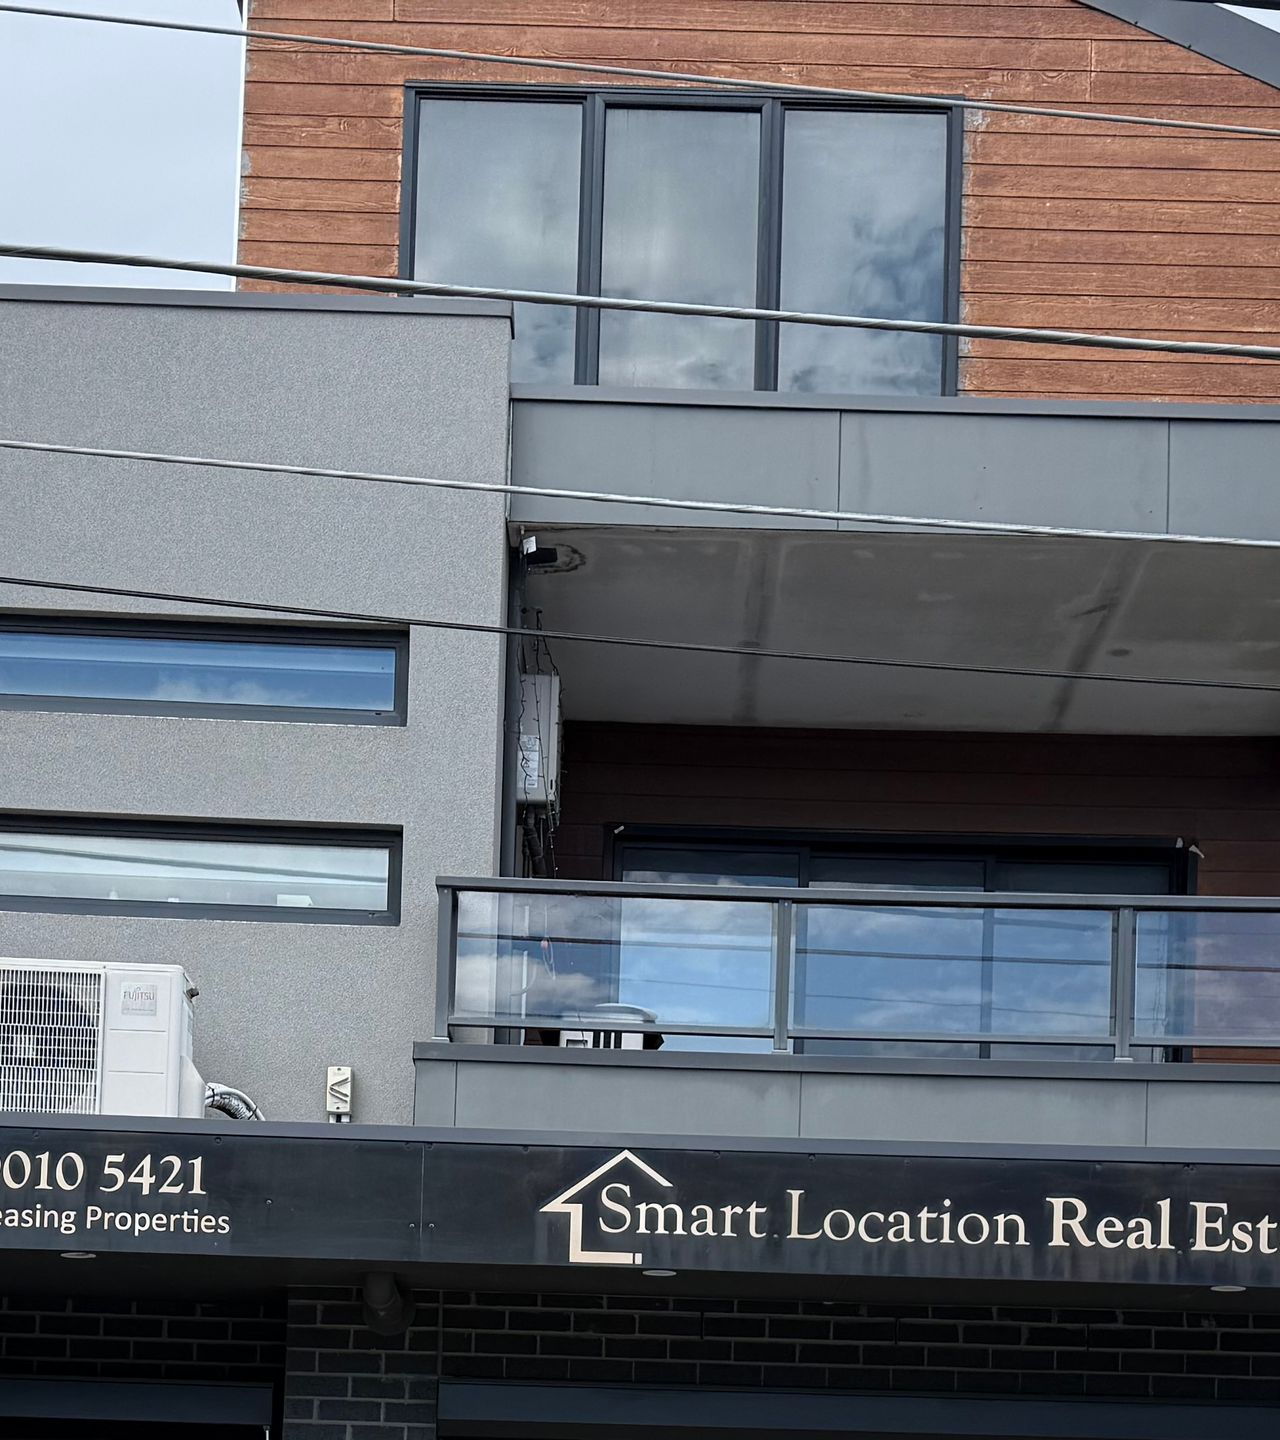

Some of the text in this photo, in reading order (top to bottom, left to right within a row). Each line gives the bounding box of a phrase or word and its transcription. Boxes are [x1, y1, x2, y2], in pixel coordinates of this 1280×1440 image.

[123, 988, 155, 1001] FUJITSU
[99, 1153, 207, 1196] 5421
[85, 1205, 231, 1237] Properties
[598, 1182, 768, 1239] Smart
[785, 1188, 1031, 1246] Location
[1045, 1197, 1176, 1250] Real
